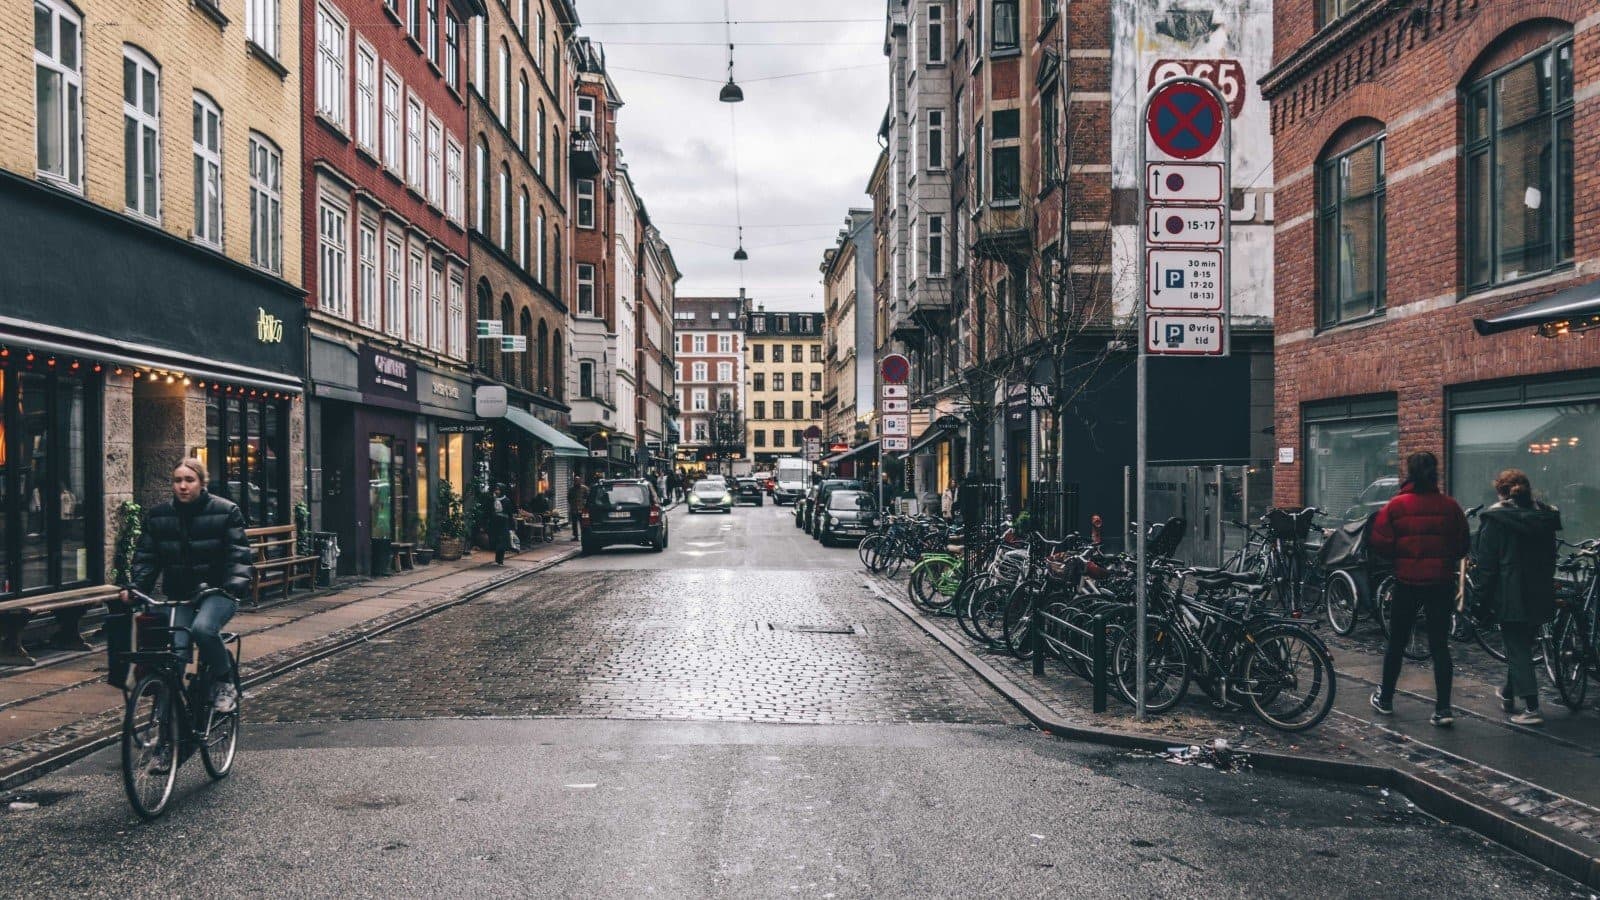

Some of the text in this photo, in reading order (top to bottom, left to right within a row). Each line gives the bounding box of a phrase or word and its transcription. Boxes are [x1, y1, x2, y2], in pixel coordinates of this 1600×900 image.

[1187, 220, 1216, 230] 15-17
[1193, 270, 1211, 278] 8-15
[1190, 281, 1214, 289] 17-20
[1188, 323, 1216, 334] Øvrig
[1195, 337, 1209, 345] tid
